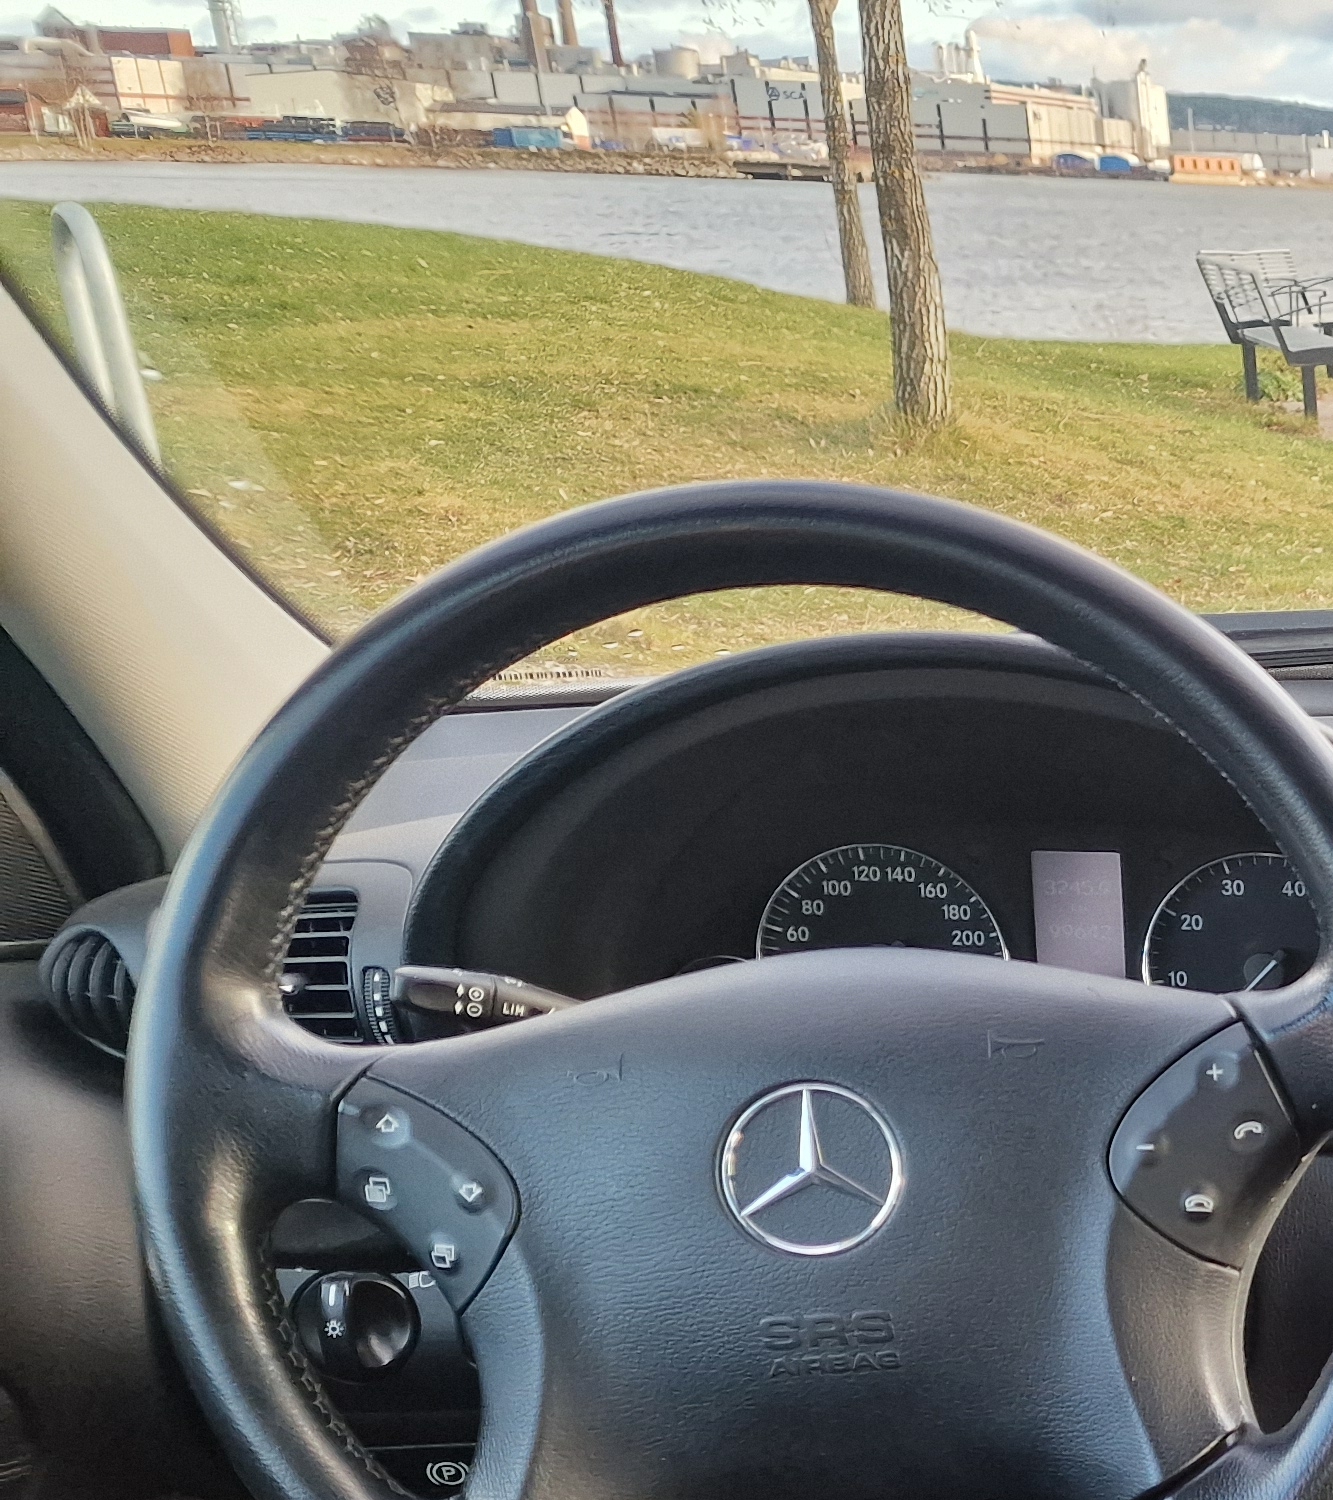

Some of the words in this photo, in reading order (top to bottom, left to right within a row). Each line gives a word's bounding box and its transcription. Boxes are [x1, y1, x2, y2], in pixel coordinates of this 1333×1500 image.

[783, 90, 805, 99] SCA
[852, 866, 880, 882] 120
[885, 866, 916, 883] 140
[822, 880, 851, 896] 100
[918, 882, 948, 899] 160
[1221, 879, 1245, 896] 30
[1281, 880, 1306, 897] 40
[801, 899, 824, 915] 80
[942, 904, 971, 921] 180
[1180, 914, 1203, 931] 20
[786, 926, 809, 942] 60
[952, 930, 985, 946] 200
[1168, 971, 1188, 987] 10
[502, 1002, 525, 1017] LIM
[759, 1310, 895, 1350] SRS
[770, 1351, 900, 1377] AIRBAG
